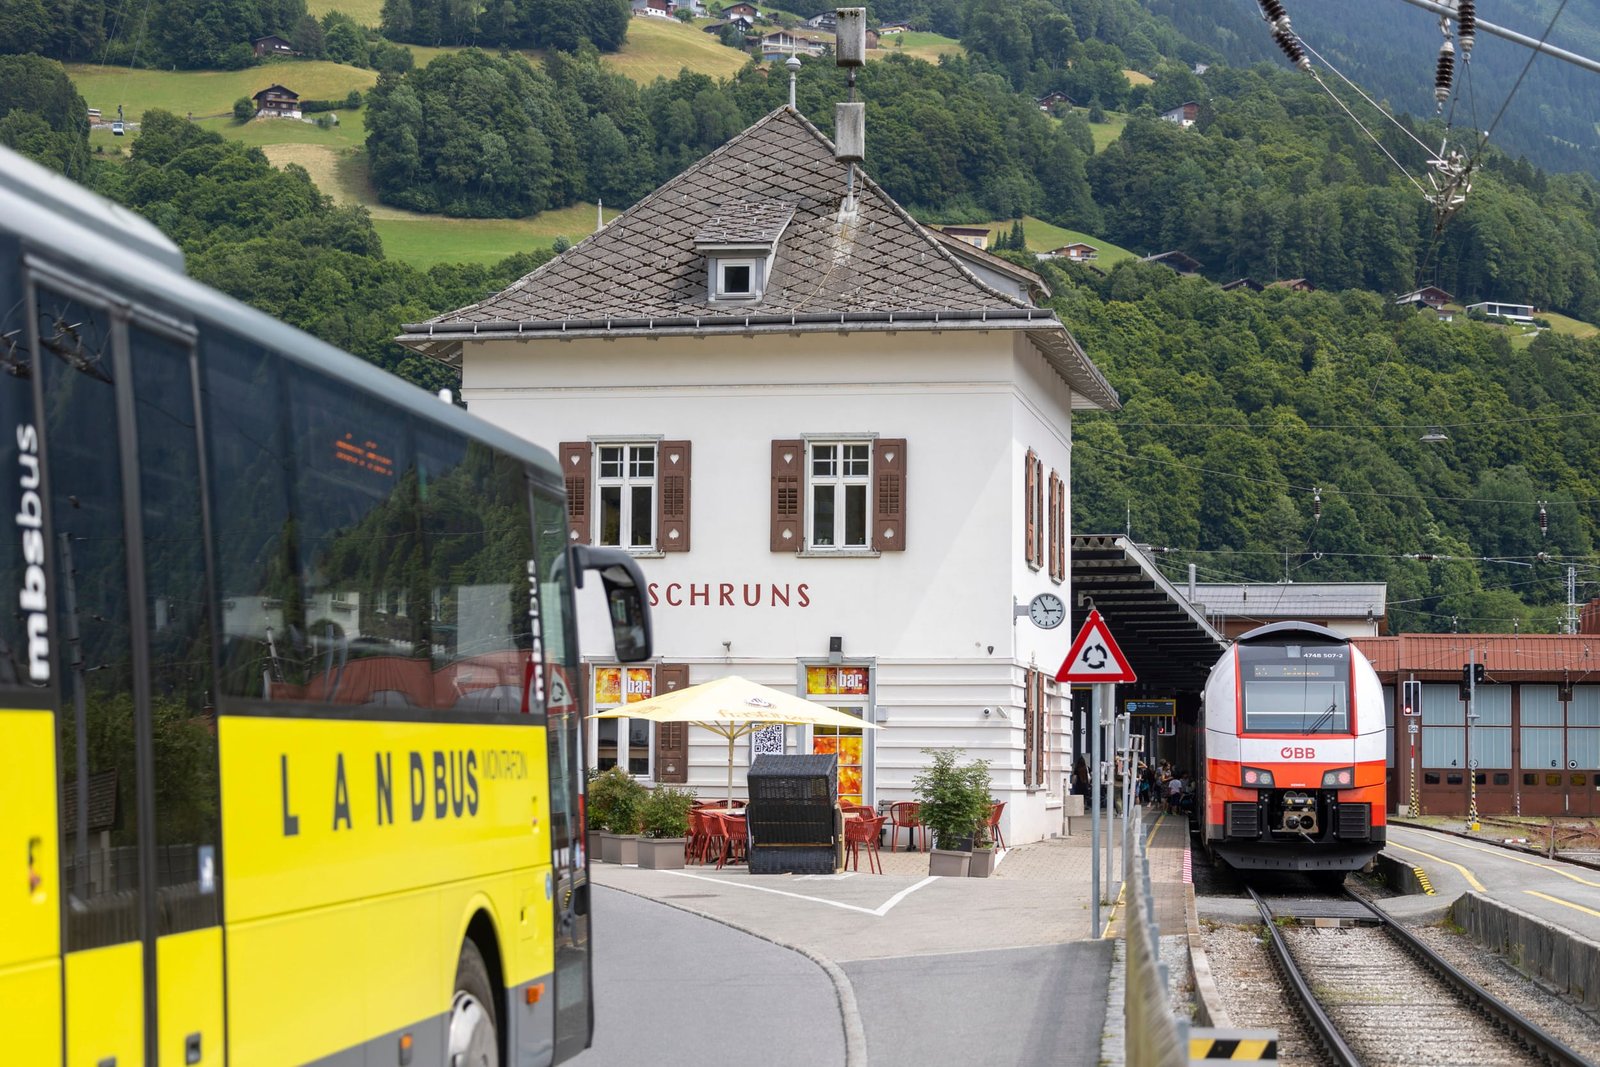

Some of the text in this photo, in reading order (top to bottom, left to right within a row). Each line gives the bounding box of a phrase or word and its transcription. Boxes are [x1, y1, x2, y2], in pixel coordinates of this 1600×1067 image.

[16, 423, 50, 681] mbsbus
[647, 583, 811, 607] SCHRUNS
[1280, 747, 1316, 759] ÖBB
[1451, 759, 1457, 767] 4
[1551, 759, 1557, 767] 6
